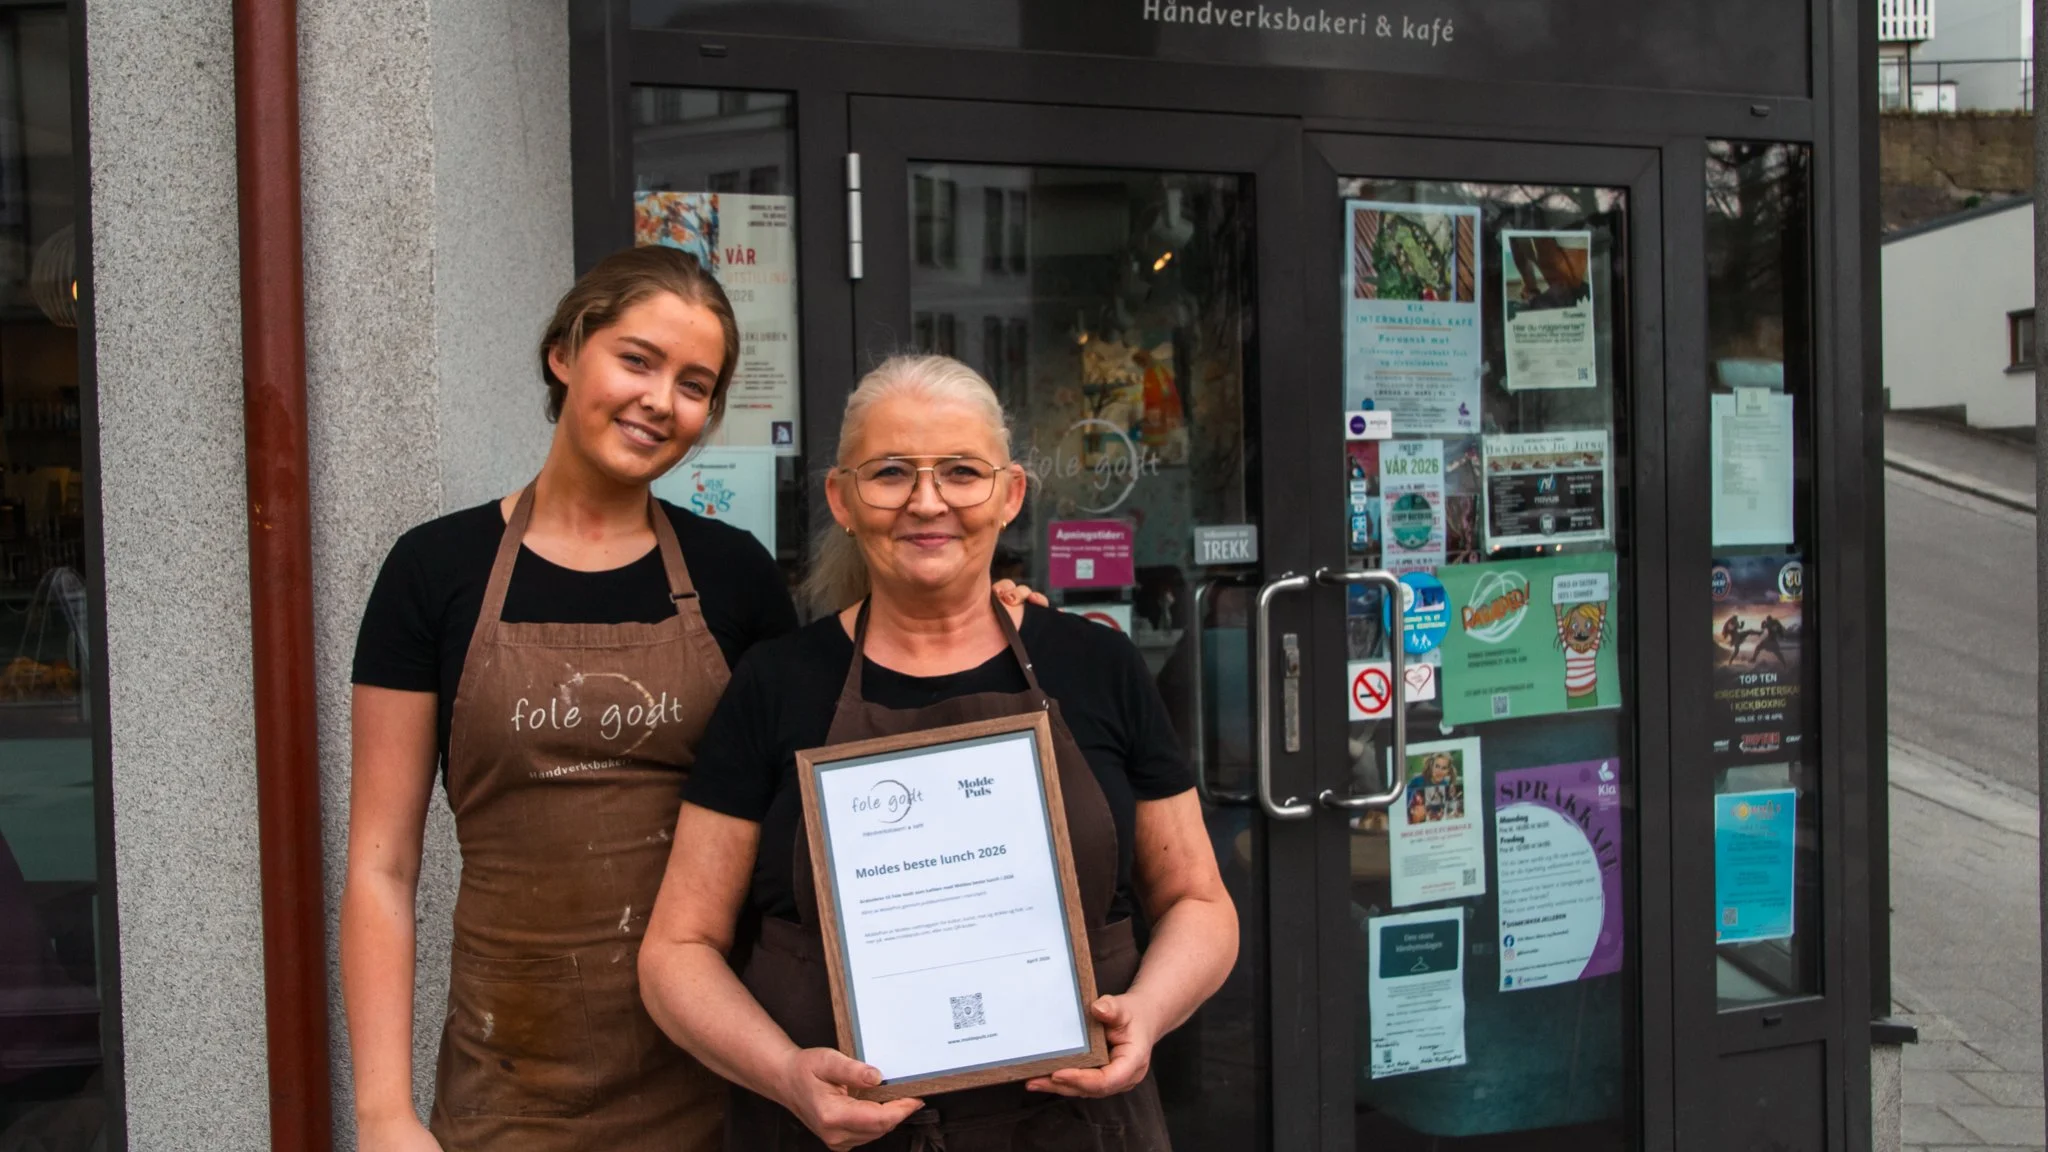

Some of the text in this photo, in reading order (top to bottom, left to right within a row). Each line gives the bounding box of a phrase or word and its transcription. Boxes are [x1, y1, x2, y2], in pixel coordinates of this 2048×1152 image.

[1143, 0, 1454, 47] Håndverksbakeri & kafé
[725, 244, 756, 265] VÅR
[1356, 315, 1442, 326] INTERNASJONAL
[1093, 446, 1160, 490] godt
[1384, 454, 1439, 475] VÅR 2026
[1203, 538, 1250, 562] TREKK
[1740, 673, 1777, 685] TOP TEN
[1714, 686, 1800, 700] ORGESMESTERSKA
[1735, 697, 1786, 712] KICKBOXING
[510, 692, 683, 740] fole godt
[957, 776, 995, 789] Molde
[965, 787, 991, 798] Puls
[1598, 785, 1616, 797] Kia
[852, 788, 924, 812] fole godt
[1499, 814, 1529, 824] Mandag
[1500, 836, 1525, 845] Fredag
[855, 845, 1007, 879] Moldes beste lunch 2026
